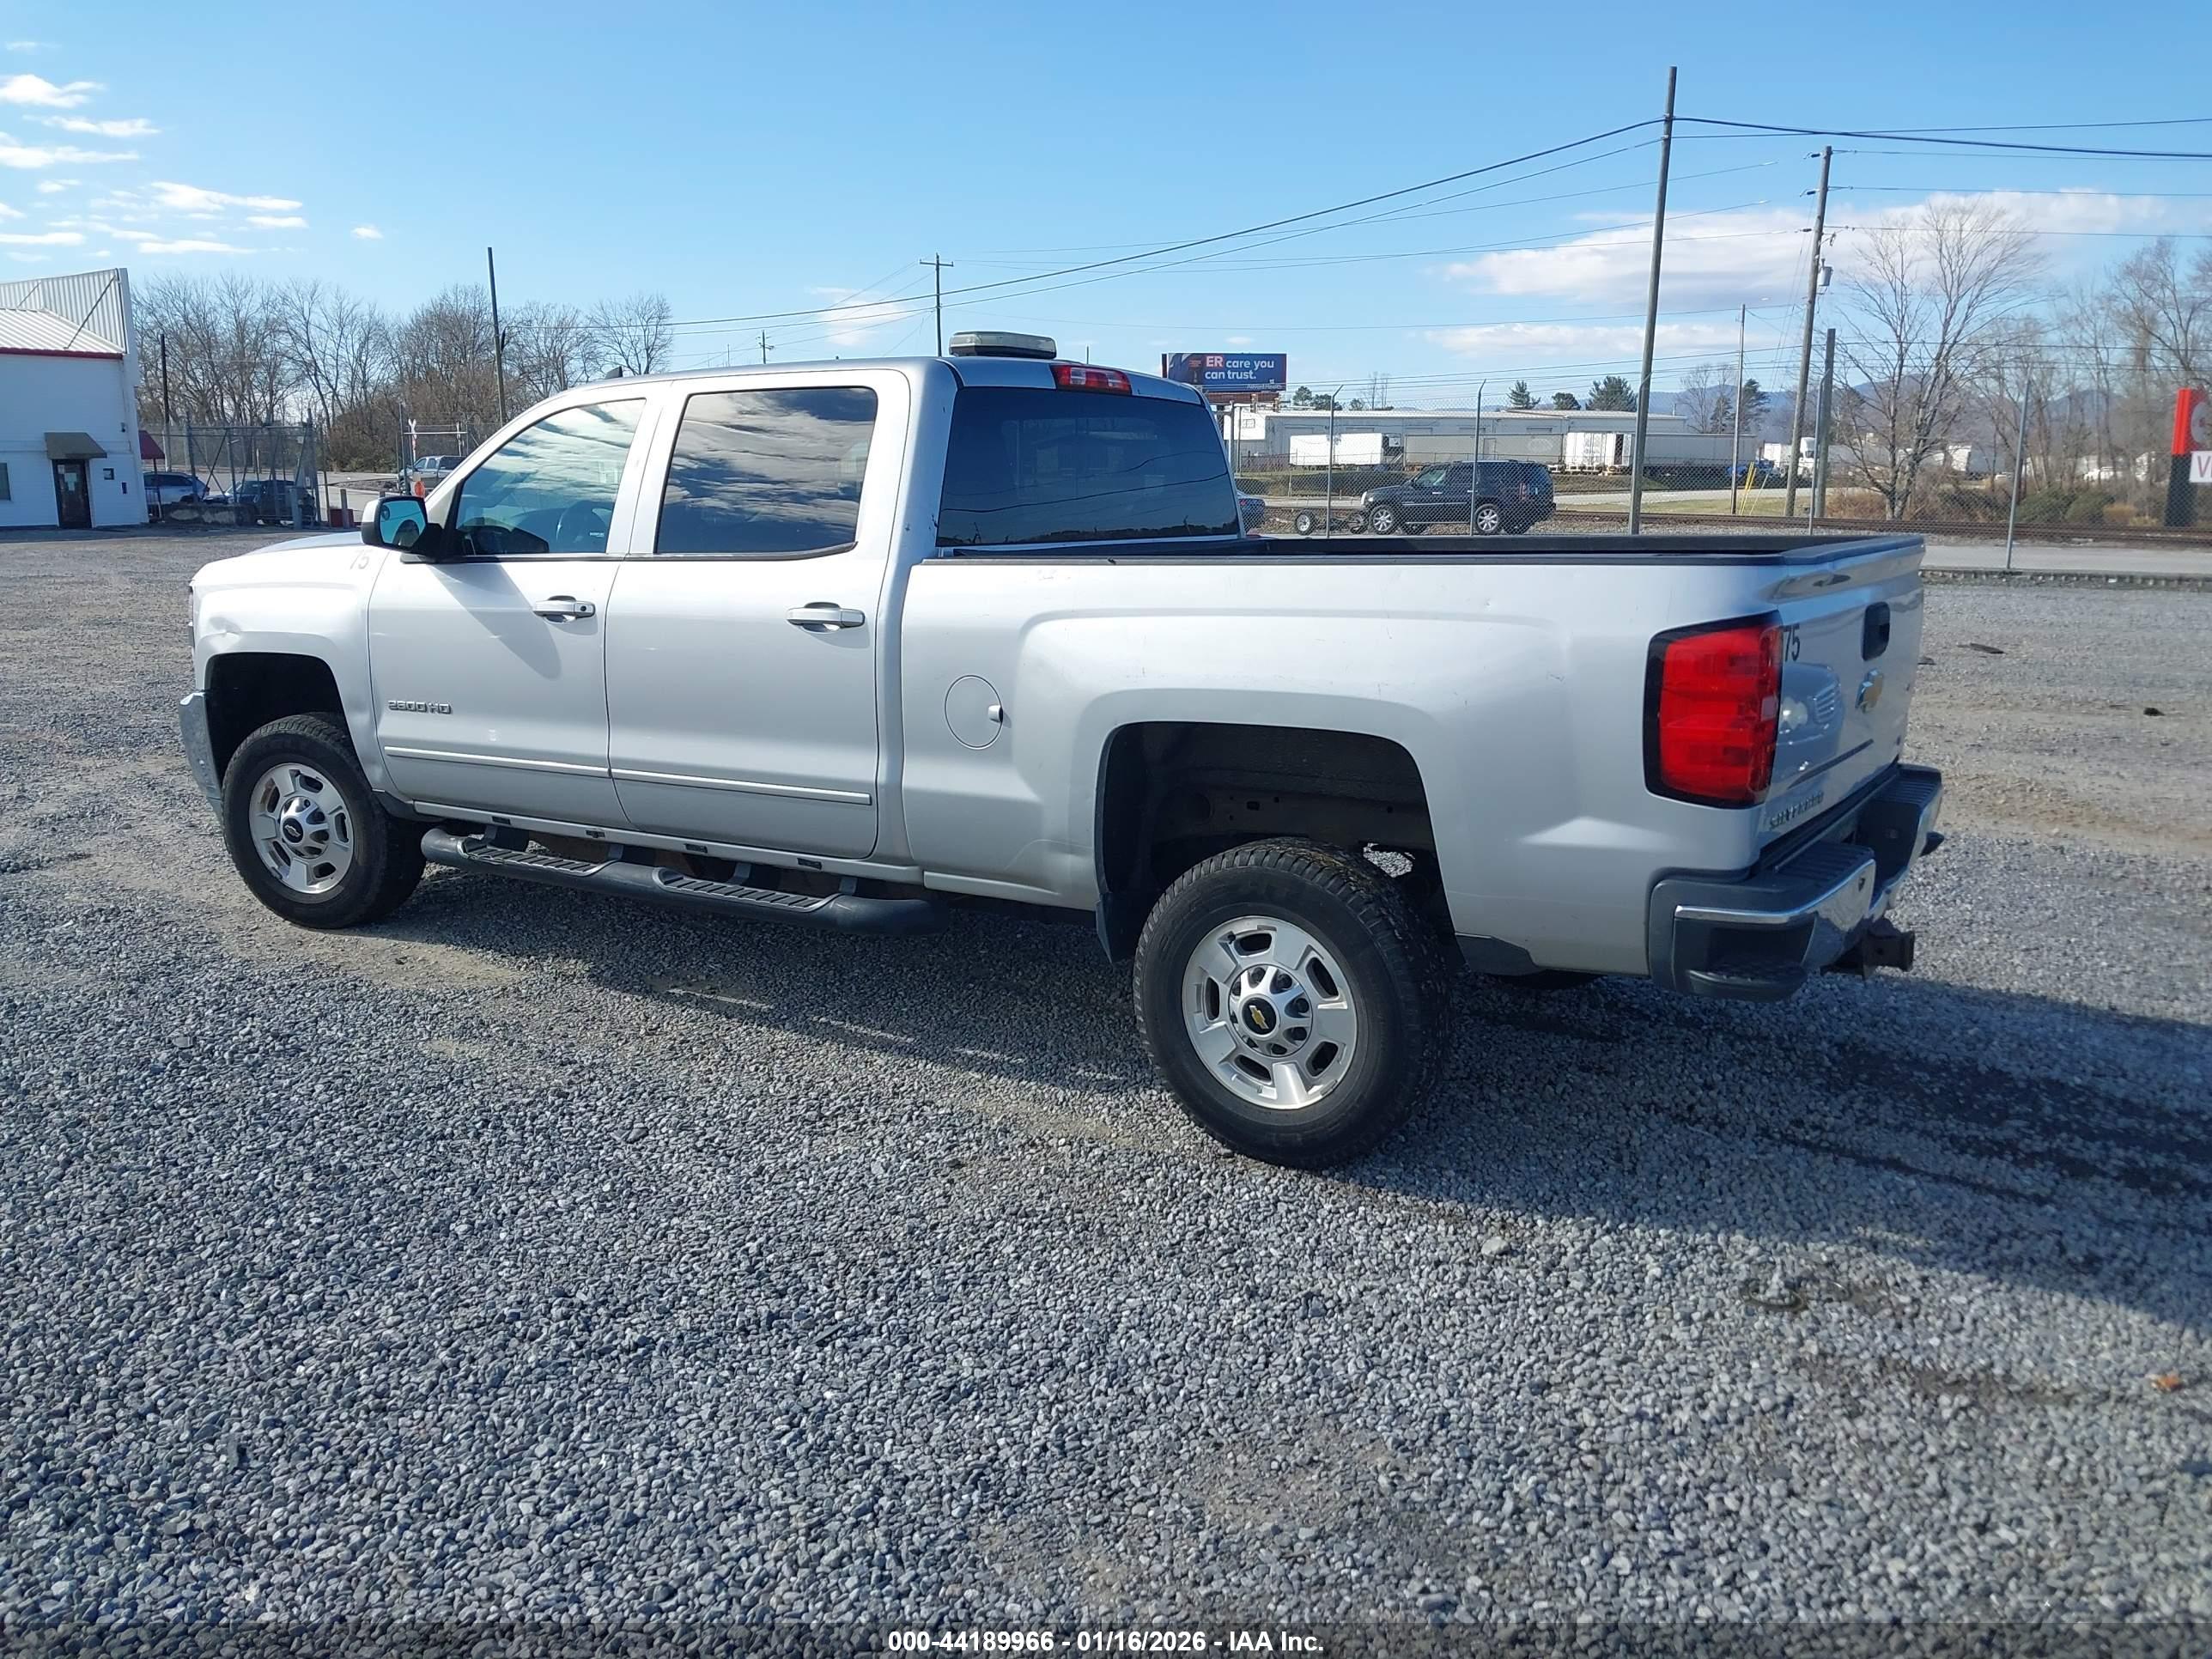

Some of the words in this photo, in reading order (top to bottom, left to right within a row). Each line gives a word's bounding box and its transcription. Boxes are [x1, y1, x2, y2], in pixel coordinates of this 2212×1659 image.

[1206, 356, 1224, 368] ER
[1253, 361, 1275, 371] you
[1205, 371, 1225, 380] can
[1227, 369, 1257, 380] trust.
[350, 548, 372, 570] 75
[1783, 622, 1801, 662] 75
